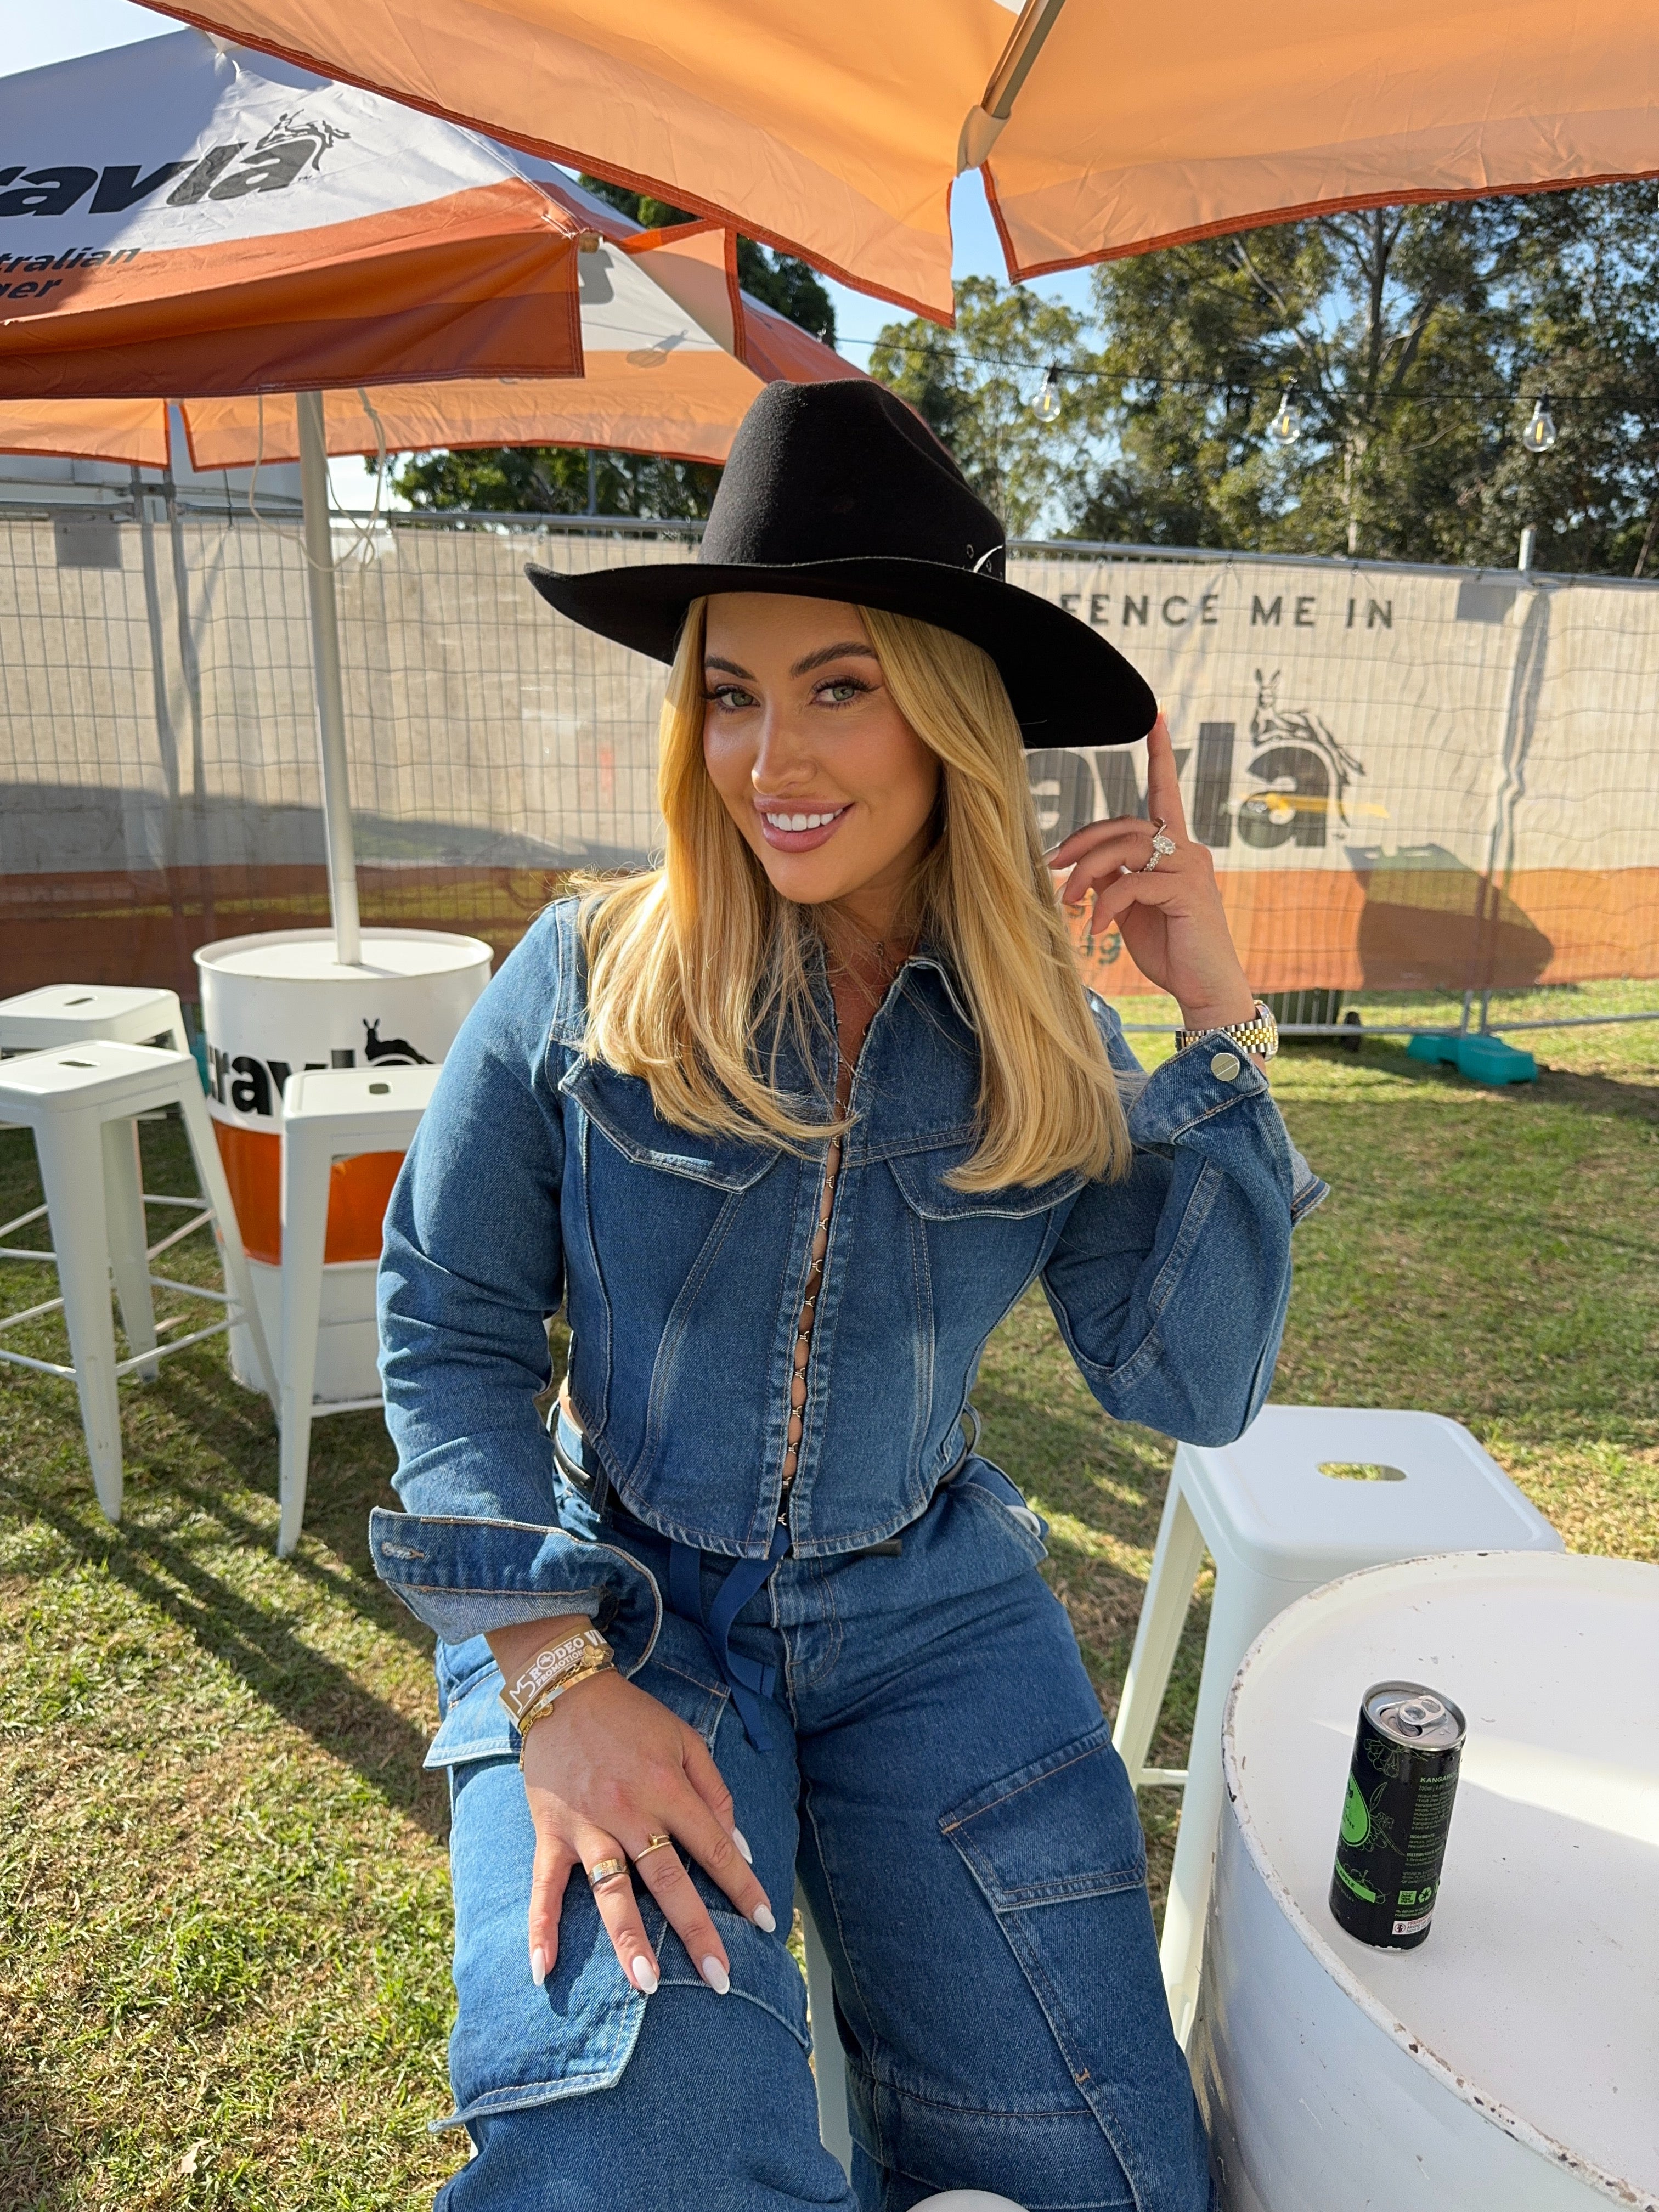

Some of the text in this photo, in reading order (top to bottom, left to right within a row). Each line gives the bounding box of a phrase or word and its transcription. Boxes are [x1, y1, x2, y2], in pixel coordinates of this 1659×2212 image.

[0, 247, 142, 273] tralian
[1250, 595, 1317, 627] ME
[1346, 598, 1394, 630] IN
